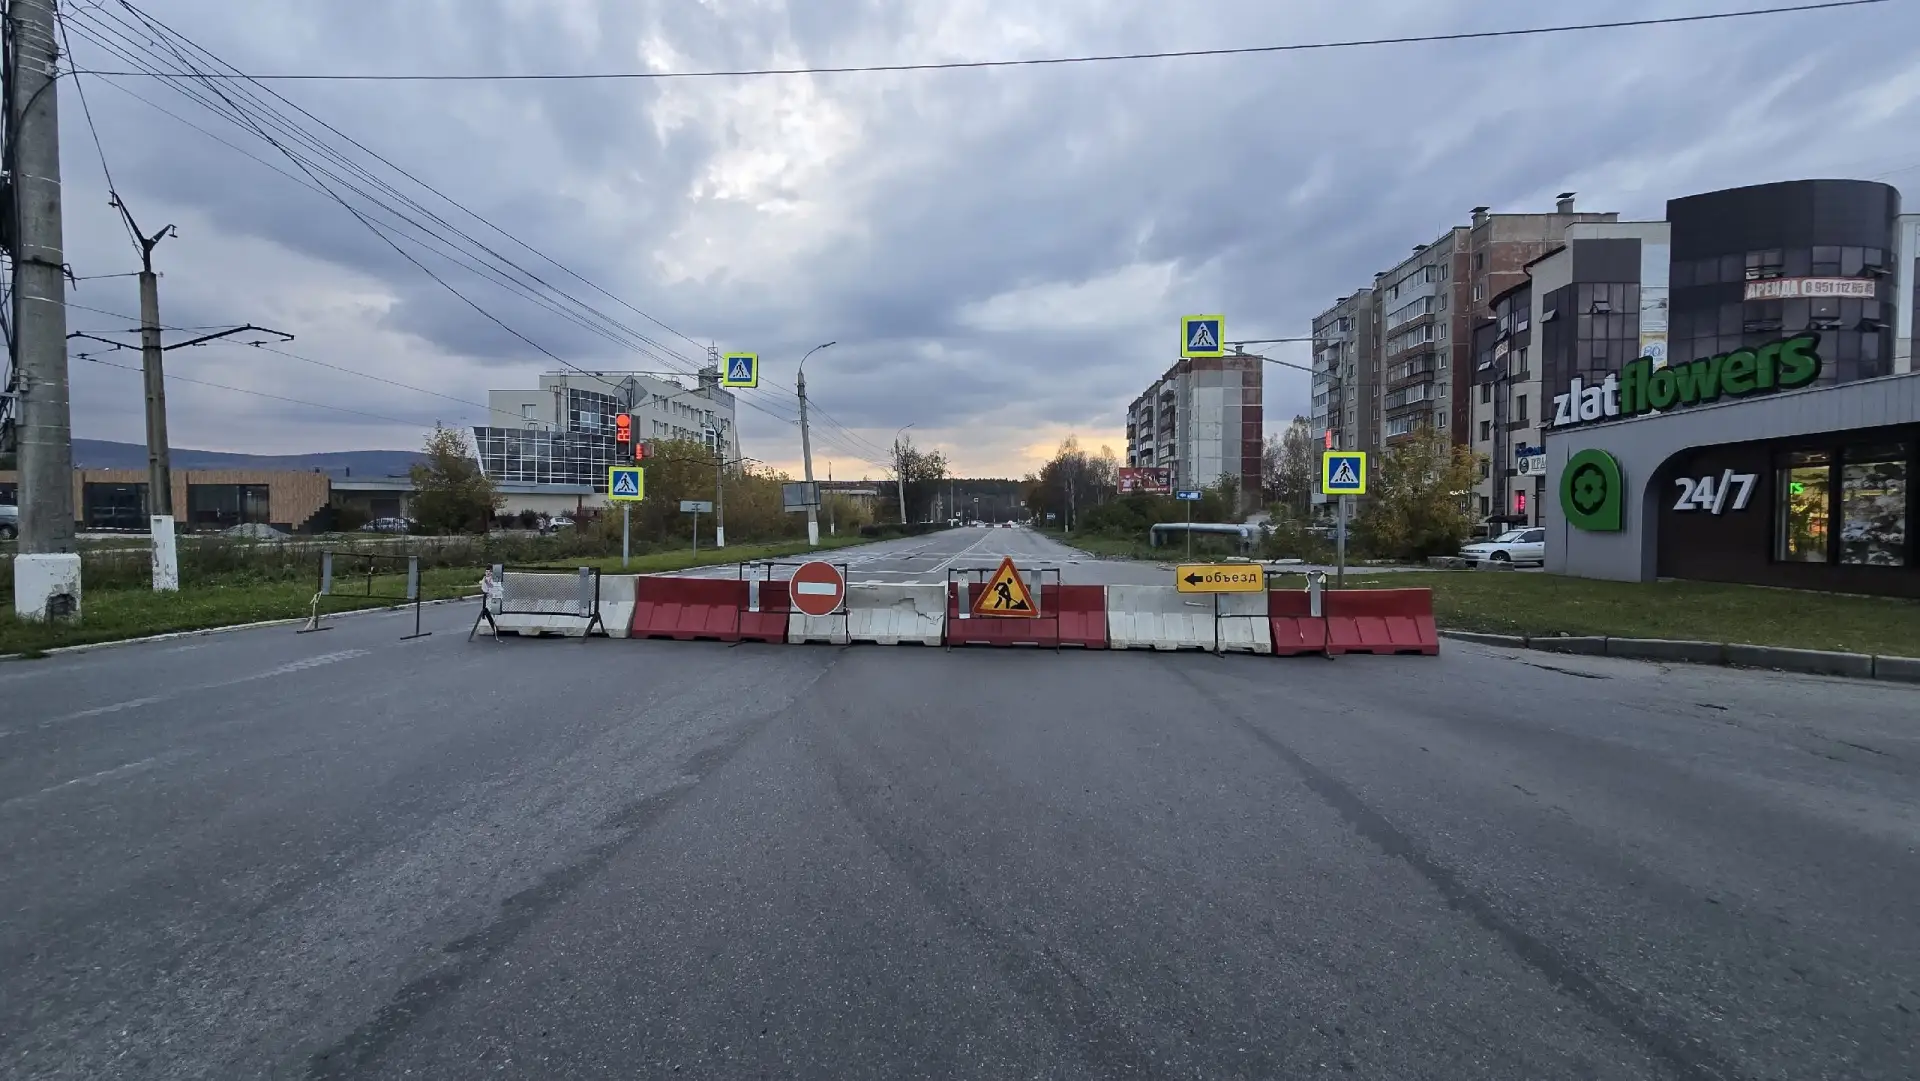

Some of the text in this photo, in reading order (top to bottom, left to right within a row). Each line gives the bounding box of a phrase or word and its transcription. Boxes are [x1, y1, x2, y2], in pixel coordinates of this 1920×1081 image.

[1746, 280, 1798, 298] АРЕНДА
[1815, 281, 1833, 293] 951
[1836, 281, 1850, 293] 112
[1673, 469, 1759, 515] 24/7
[1206, 572, 1256, 584] объезд
